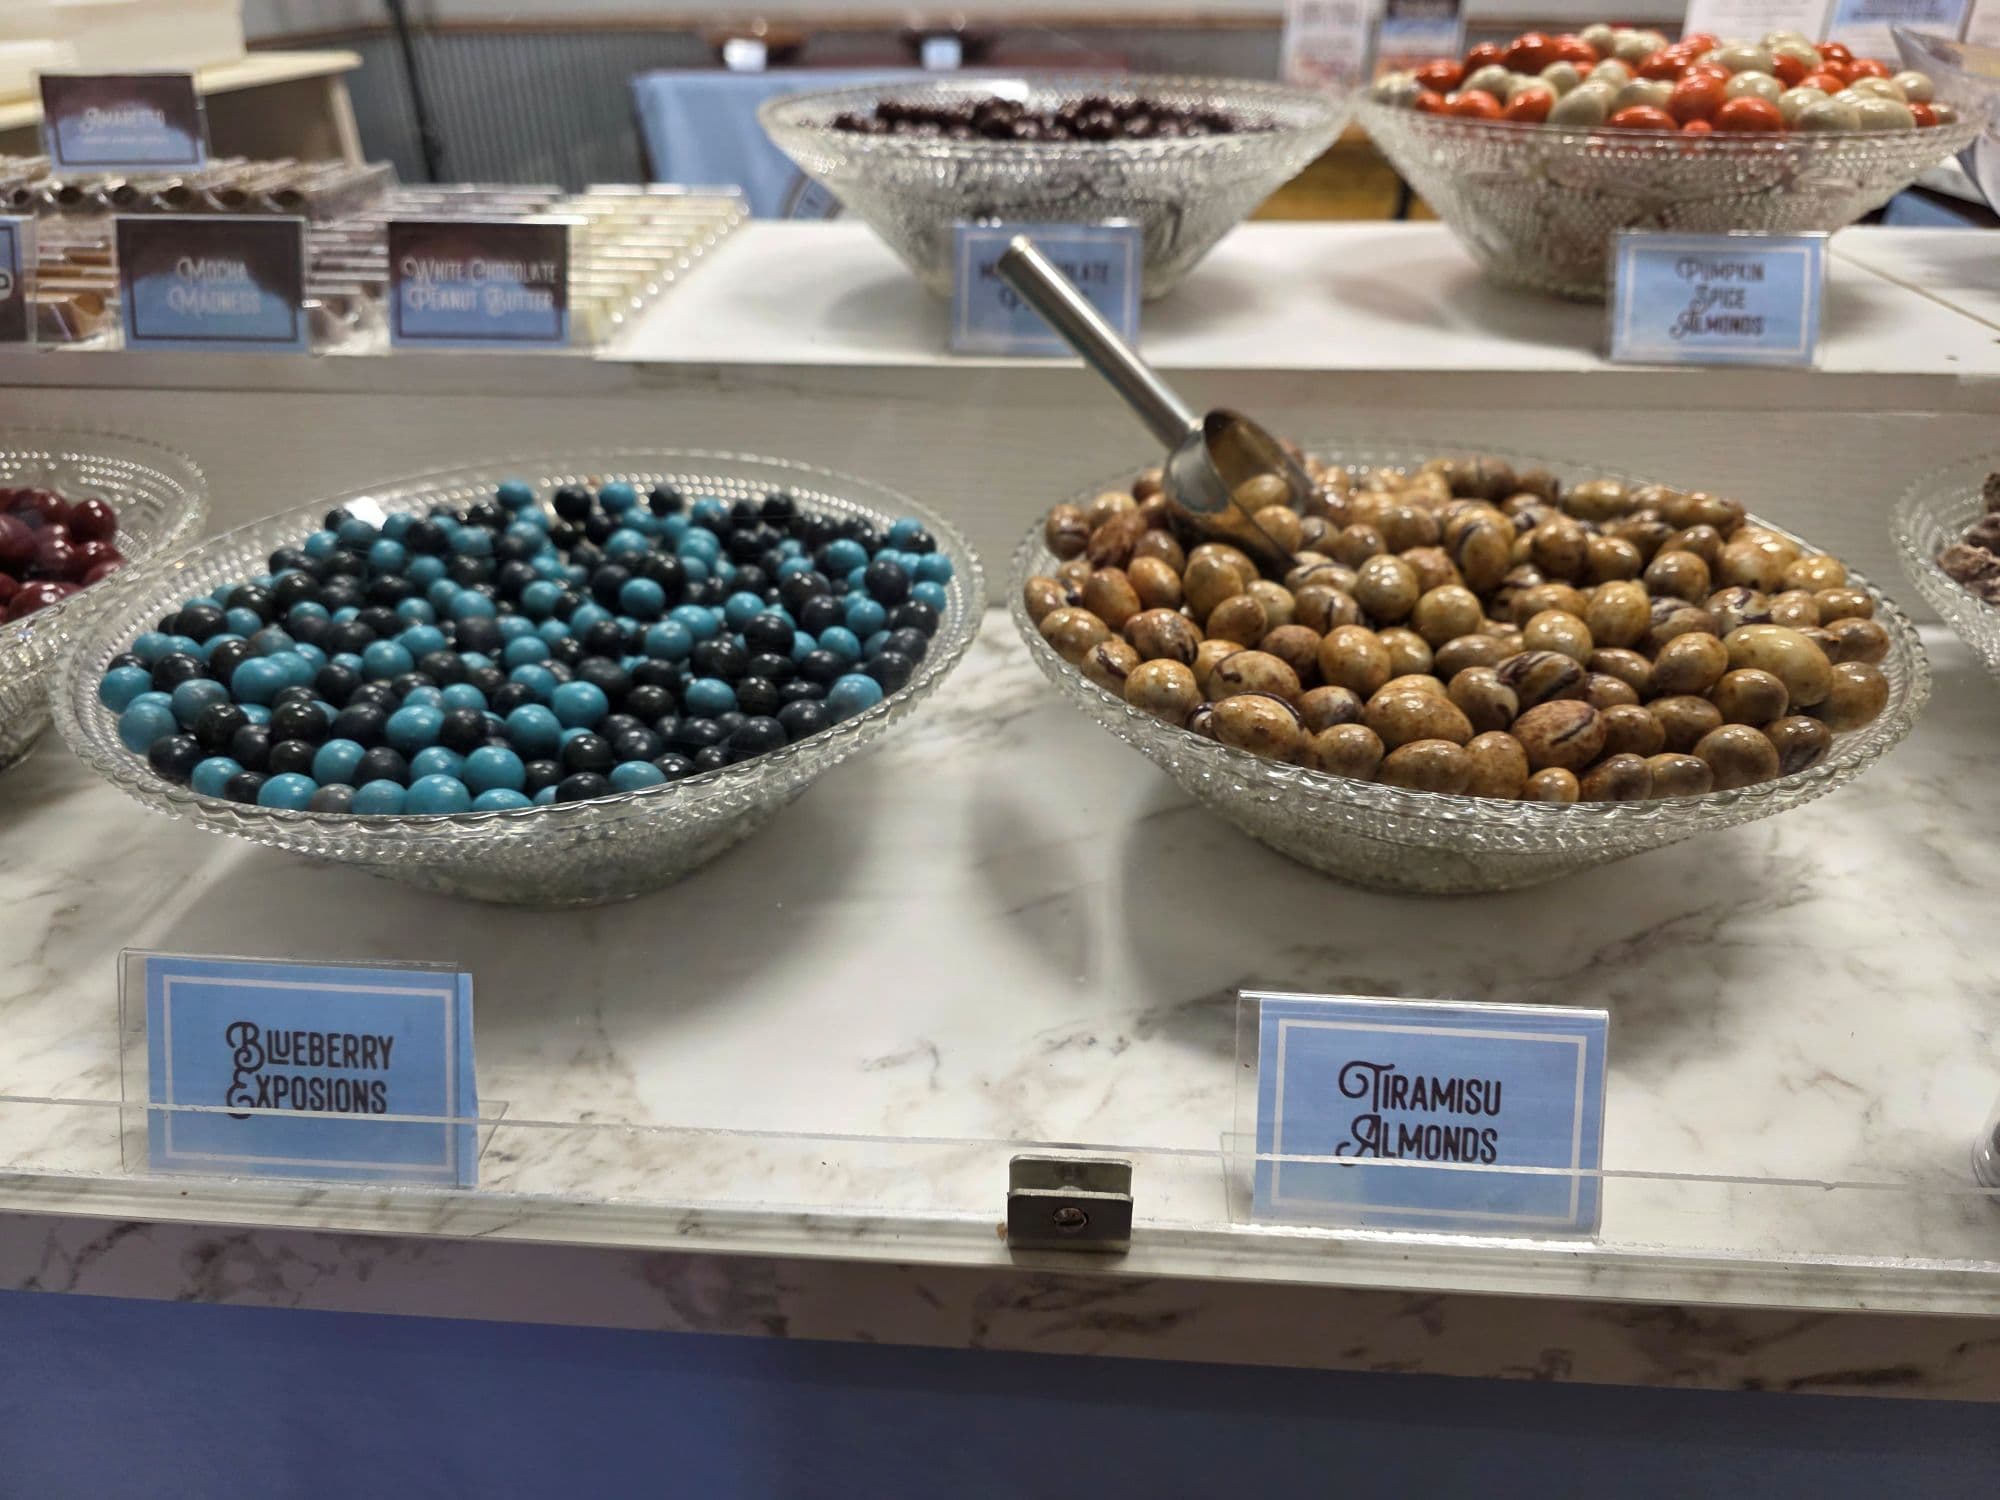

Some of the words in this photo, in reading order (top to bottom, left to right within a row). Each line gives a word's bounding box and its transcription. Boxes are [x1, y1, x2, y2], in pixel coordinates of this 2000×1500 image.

[176, 256, 248, 284] MOCHA
[401, 256, 464, 289] WHITE
[469, 257, 557, 286] CHOCOLATE
[1675, 256, 1765, 281] PUMPKIN
[409, 286, 477, 312] PEANUT
[486, 287, 554, 316] BUTTER
[1689, 284, 1746, 313] SPICE
[1669, 311, 1765, 339] ALMONDS
[225, 1021, 394, 1074] BLUEBERRY
[225, 1066, 388, 1120] EXPOSIONS
[1338, 1060, 1502, 1116] TIRAMISU
[1334, 1114, 1498, 1167] ALMONDS
